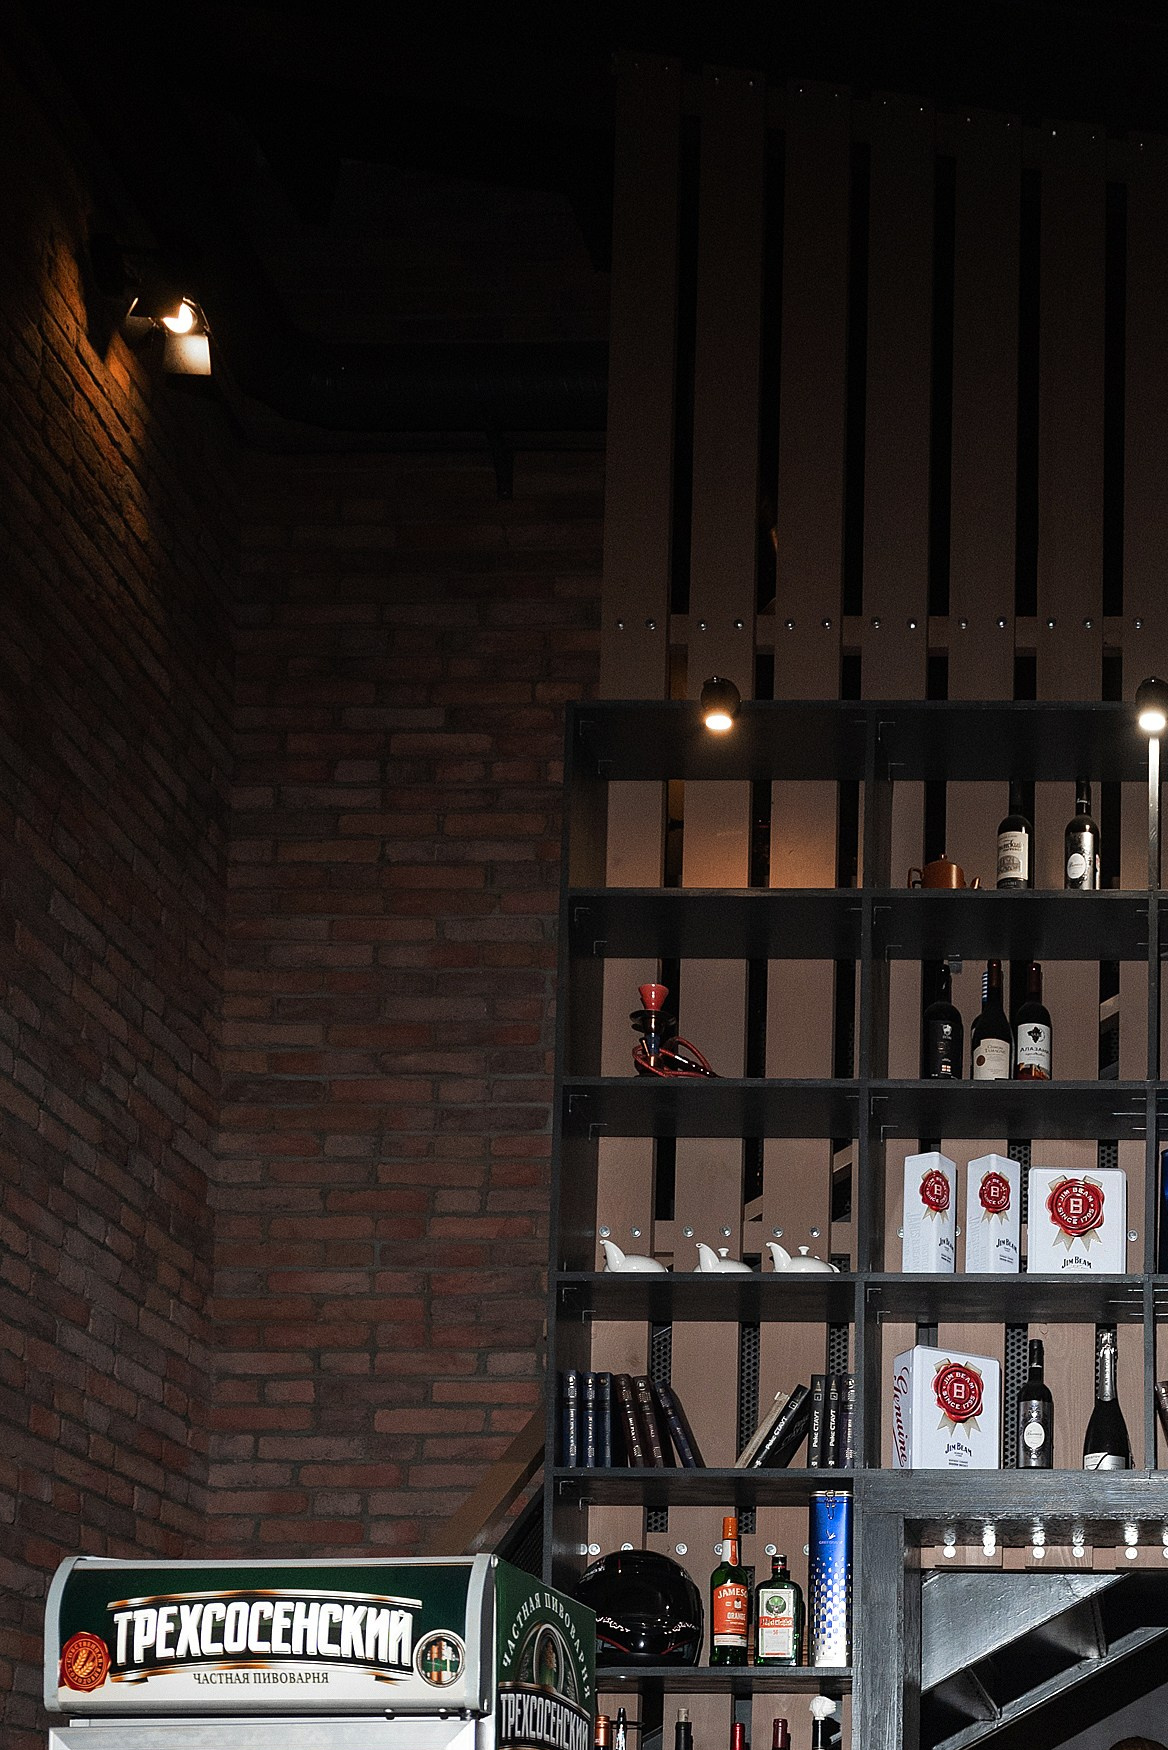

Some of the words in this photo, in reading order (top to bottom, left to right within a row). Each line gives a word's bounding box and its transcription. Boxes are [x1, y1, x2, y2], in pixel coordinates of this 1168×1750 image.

[1059, 1189, 1070, 1202] JIM
[1072, 1187, 1094, 1203] BEAM
[1070, 1198, 1083, 1214] B
[1058, 1207, 1078, 1224] SINCE
[1062, 1258, 1074, 1269] JIM
[944, 1373, 954, 1385] JIM
[956, 1372, 975, 1389] BEAM
[953, 1383, 965, 1399] B
[942, 1391, 960, 1409] SINCE
[893, 1366, 910, 1468] Genuine
[774, 1416, 788, 1436] СТАУТ
[502, 1592, 540, 1668] ЧАСТНАЯ
[544, 1592, 591, 1698] ПИВОВАРНЯ
[193, 1672, 250, 1685] ЧАСТНАЯ
[253, 1672, 329, 1685] ПИВОВАРНЯ
